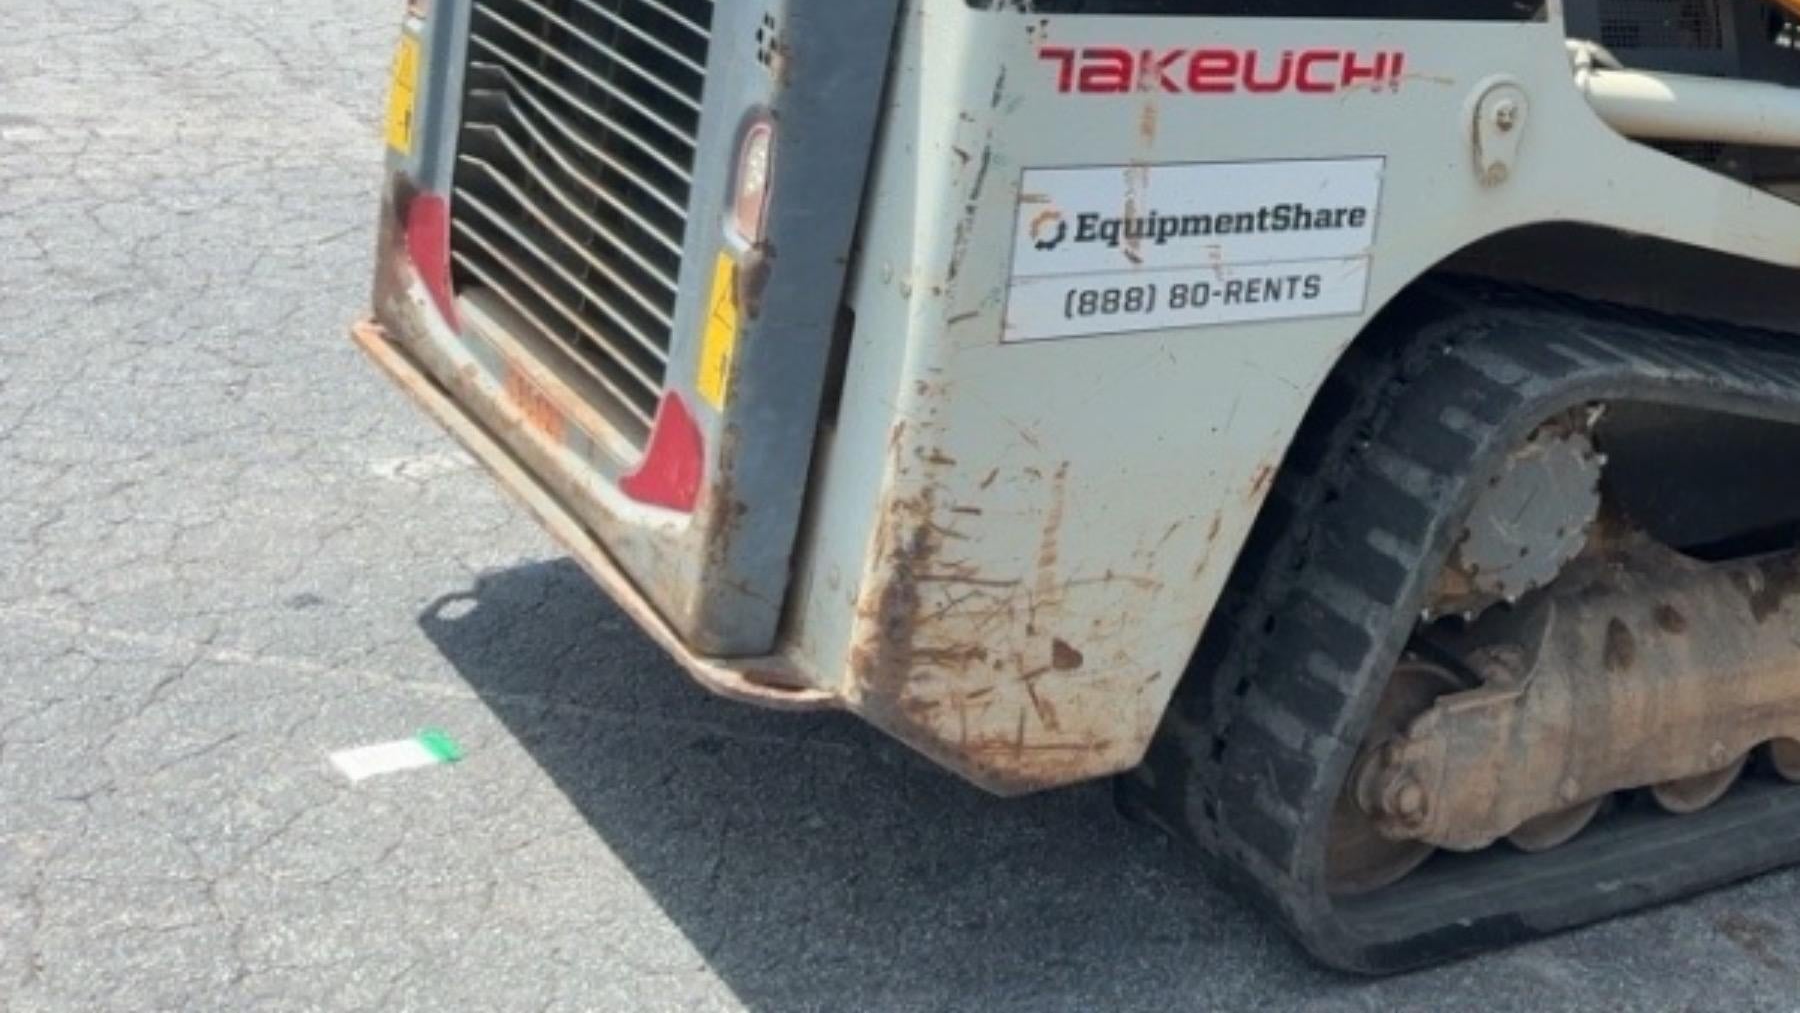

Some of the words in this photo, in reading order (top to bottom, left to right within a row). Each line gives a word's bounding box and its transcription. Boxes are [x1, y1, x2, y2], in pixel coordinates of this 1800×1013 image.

[1073, 203, 1367, 252] EquipmentShare
[1064, 289, 1157, 320] (888)
[1168, 274, 1322, 310] 80-RENTS
